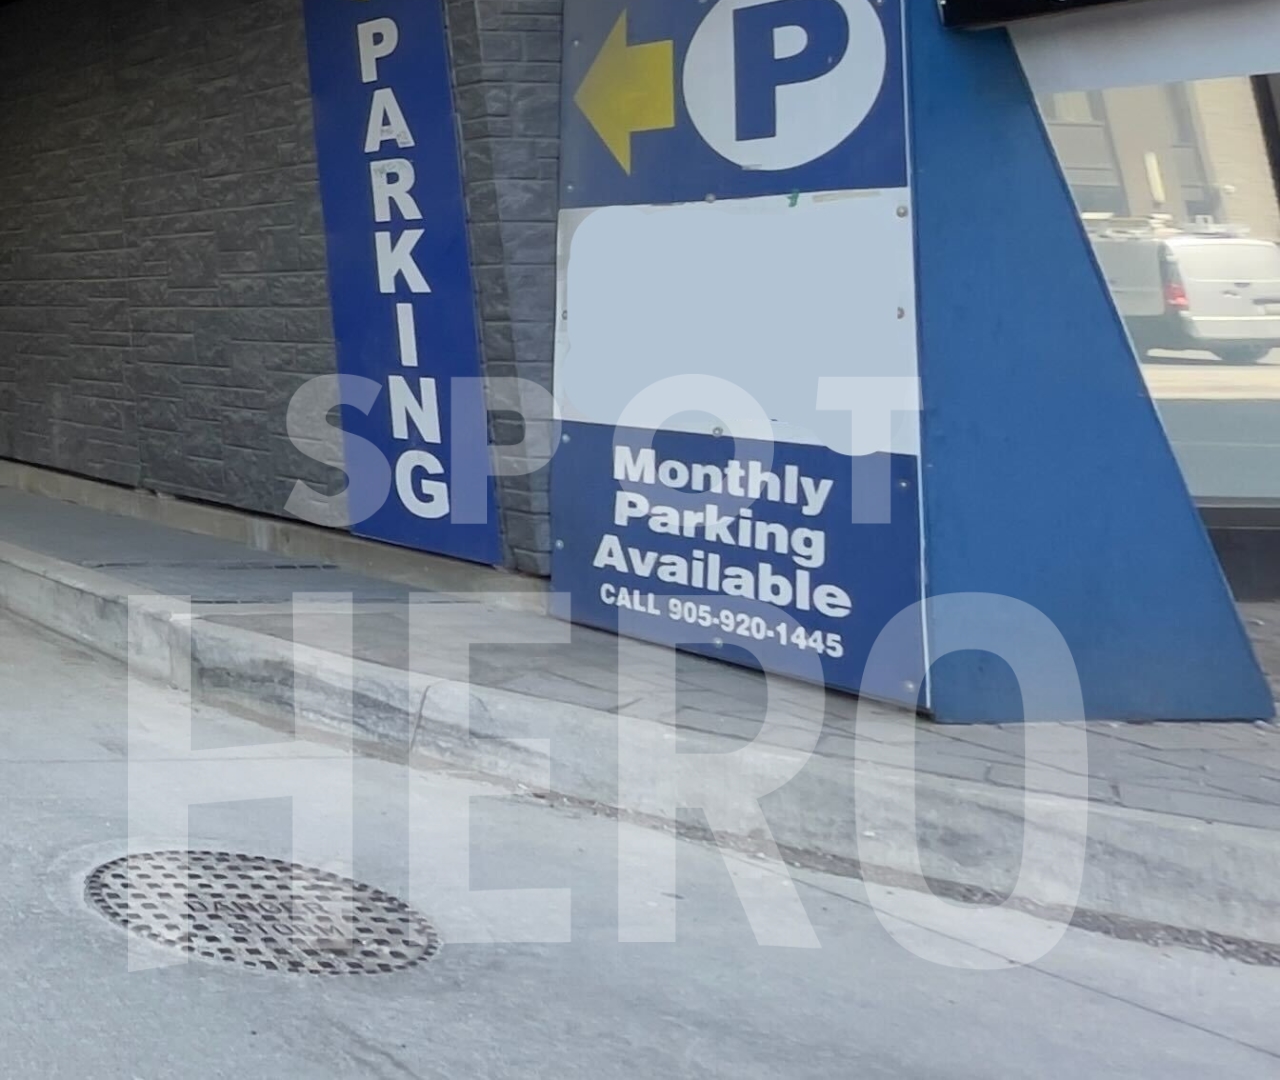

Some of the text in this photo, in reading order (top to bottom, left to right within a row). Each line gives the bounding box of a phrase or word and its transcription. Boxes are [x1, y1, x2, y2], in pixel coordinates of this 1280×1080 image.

[356, 16, 450, 519] PARKING
[613, 445, 834, 516] Monthly
[614, 491, 826, 568] Parking
[593, 533, 852, 618] Available
[600, 582, 844, 658] CALL 905-920-1445
